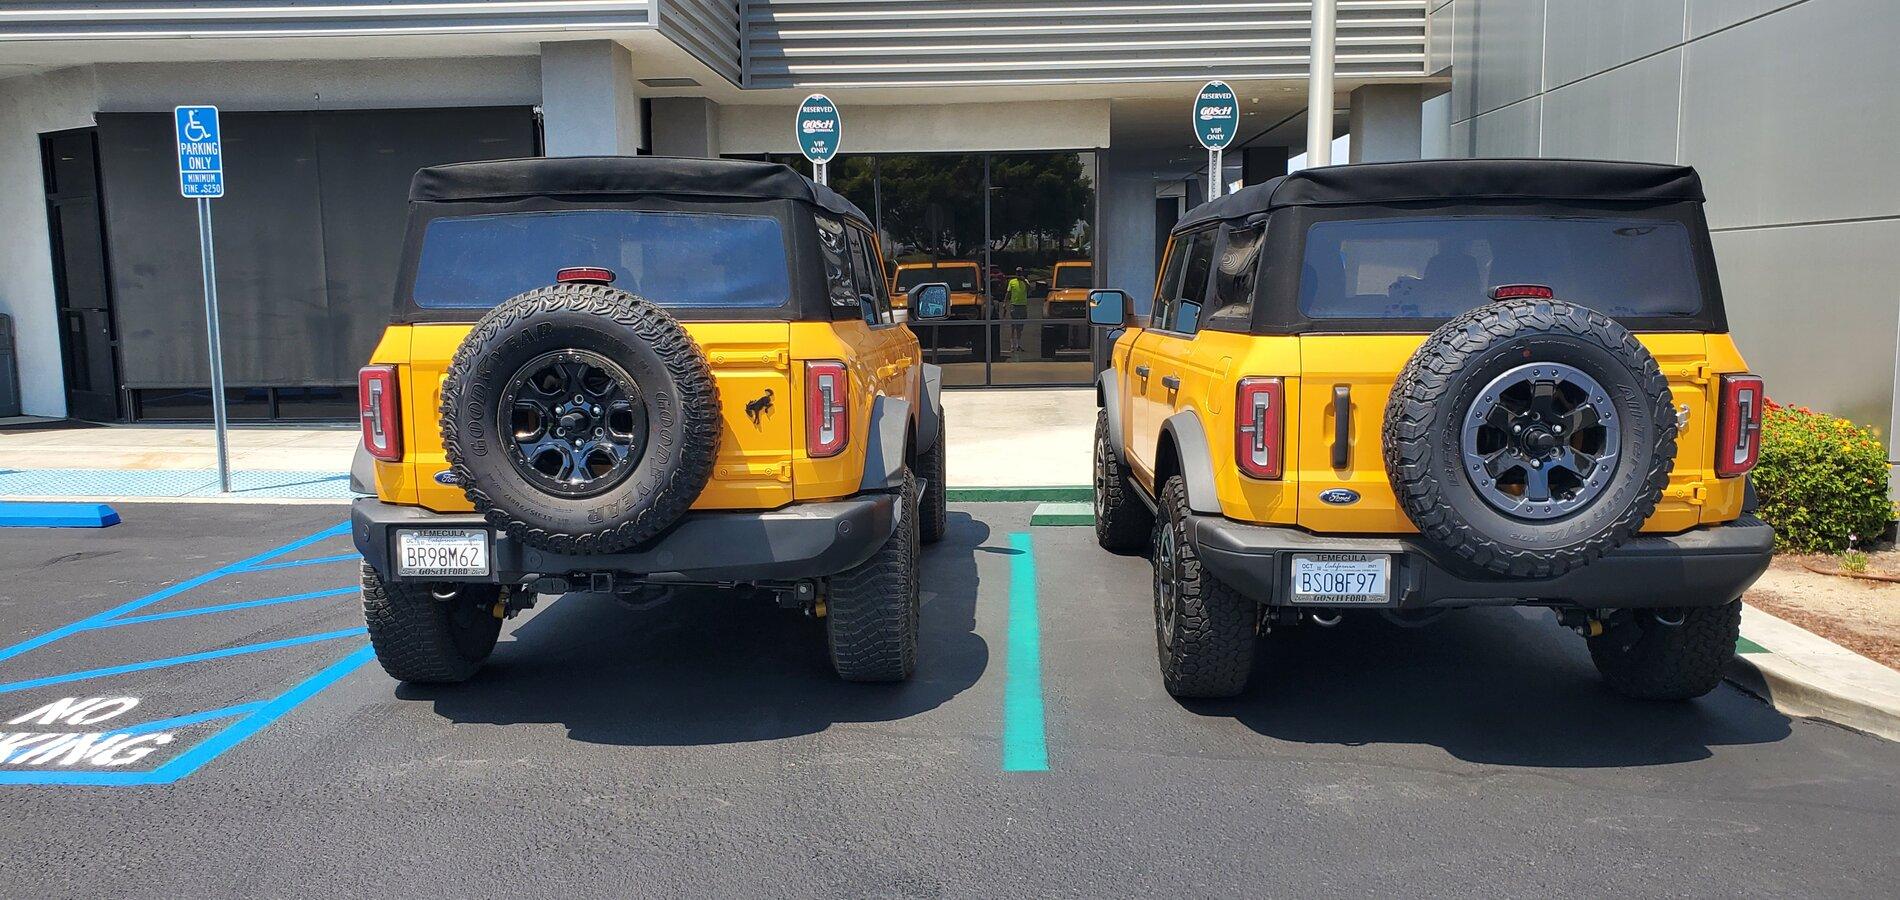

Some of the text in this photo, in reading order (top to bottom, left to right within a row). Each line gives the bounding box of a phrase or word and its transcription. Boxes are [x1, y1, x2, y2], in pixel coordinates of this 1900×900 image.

[180, 142, 218, 155] PARKING
[189, 157, 211, 169] ONLY
[188, 174, 216, 183] MINIMUM
[184, 184, 221, 193] FINE $250
[1329, 492, 1351, 502] Ford
[407, 547, 480, 567] BR98M62
[1316, 554, 1367, 562] TEMECULA
[1302, 572, 1377, 593] BS08F97
[8, 697, 139, 725] NO
